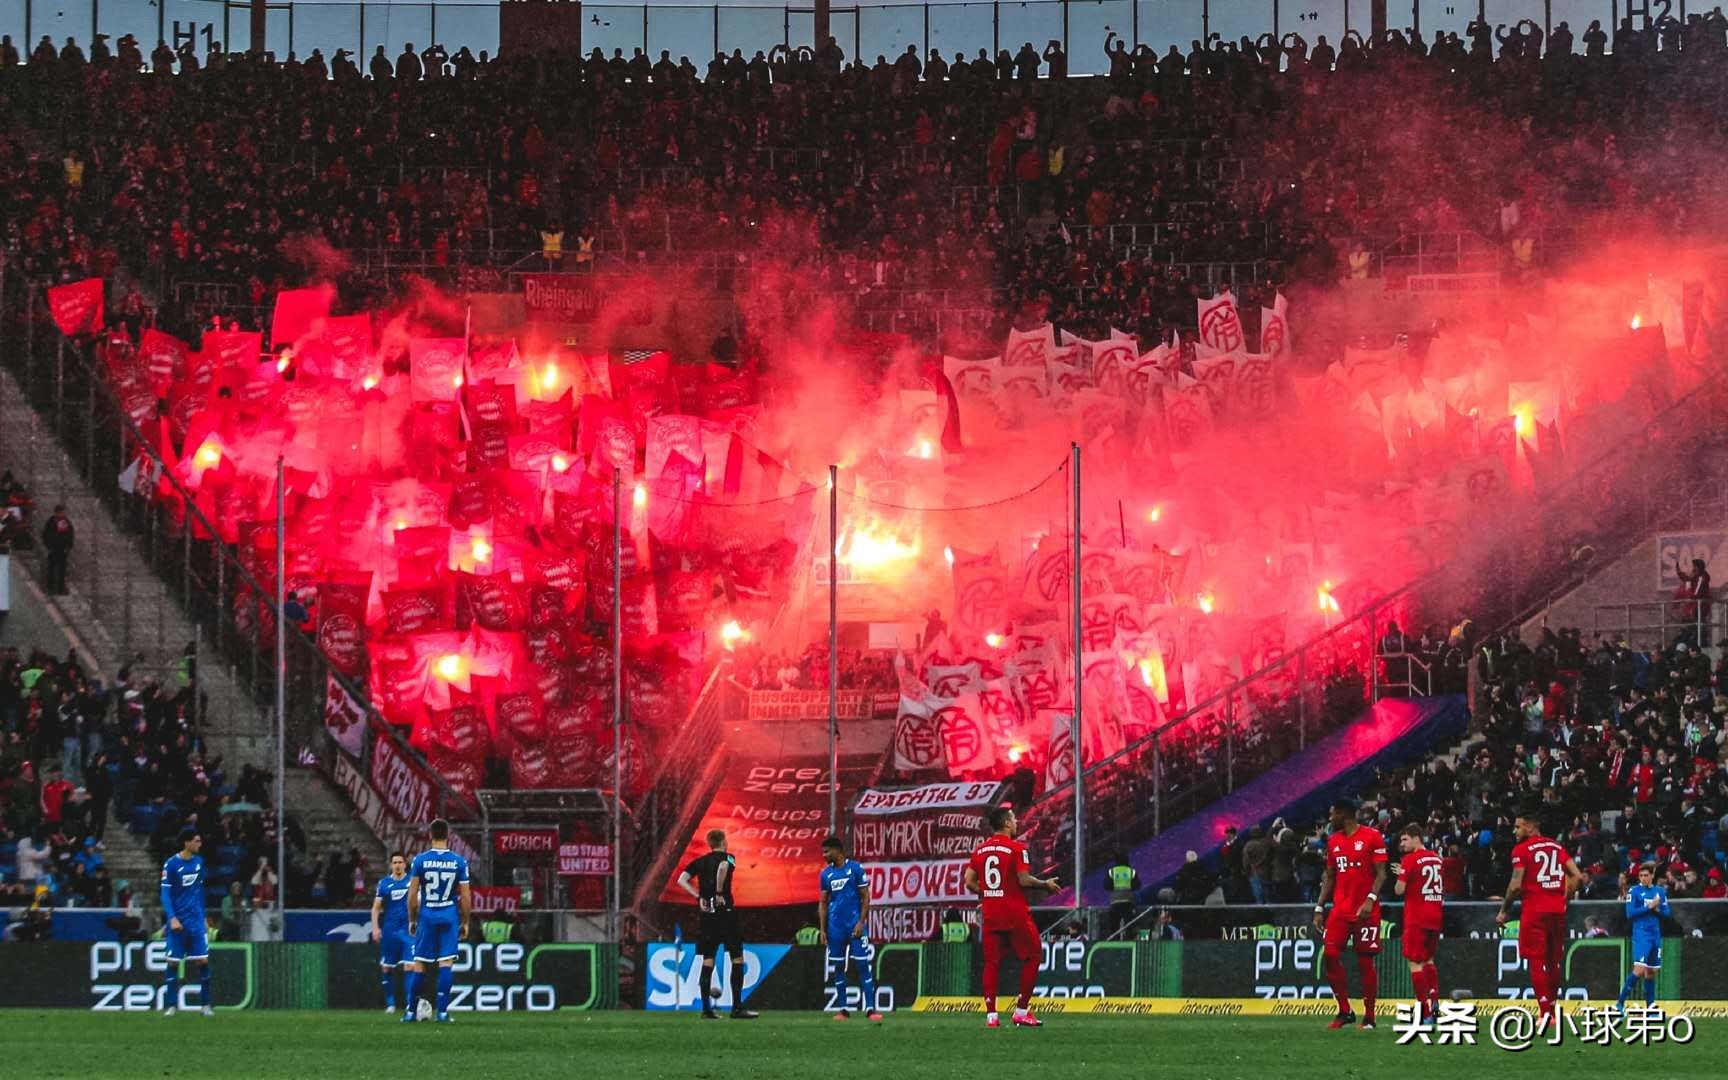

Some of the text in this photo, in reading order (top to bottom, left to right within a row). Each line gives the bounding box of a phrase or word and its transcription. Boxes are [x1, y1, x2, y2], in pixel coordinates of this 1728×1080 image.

[173, 21, 213, 52] H1
[965, 783, 996, 801] 93
[501, 832, 552, 851] ZÜRICH
[853, 818, 935, 857] NEUMARKT
[933, 835, 988, 855] HARZBUR
[561, 858, 609, 871] UNITED
[985, 855, 1001, 889] 6
[1534, 850, 1564, 882] 24
[425, 871, 456, 901] 27
[1421, 864, 1443, 894] 25
[1361, 926, 1378, 941] 27
[91, 941, 168, 981] pre
[1256, 939, 1316, 980] pre
[648, 946, 762, 1008] SAP
[446, 985, 556, 1012] zero
[925, 998, 982, 1012] interwetten
[1092, 998, 1153, 1013] interwetten
[1179, 1000, 1243, 1015] interwetten
[1270, 1000, 1338, 1016] interwetten
